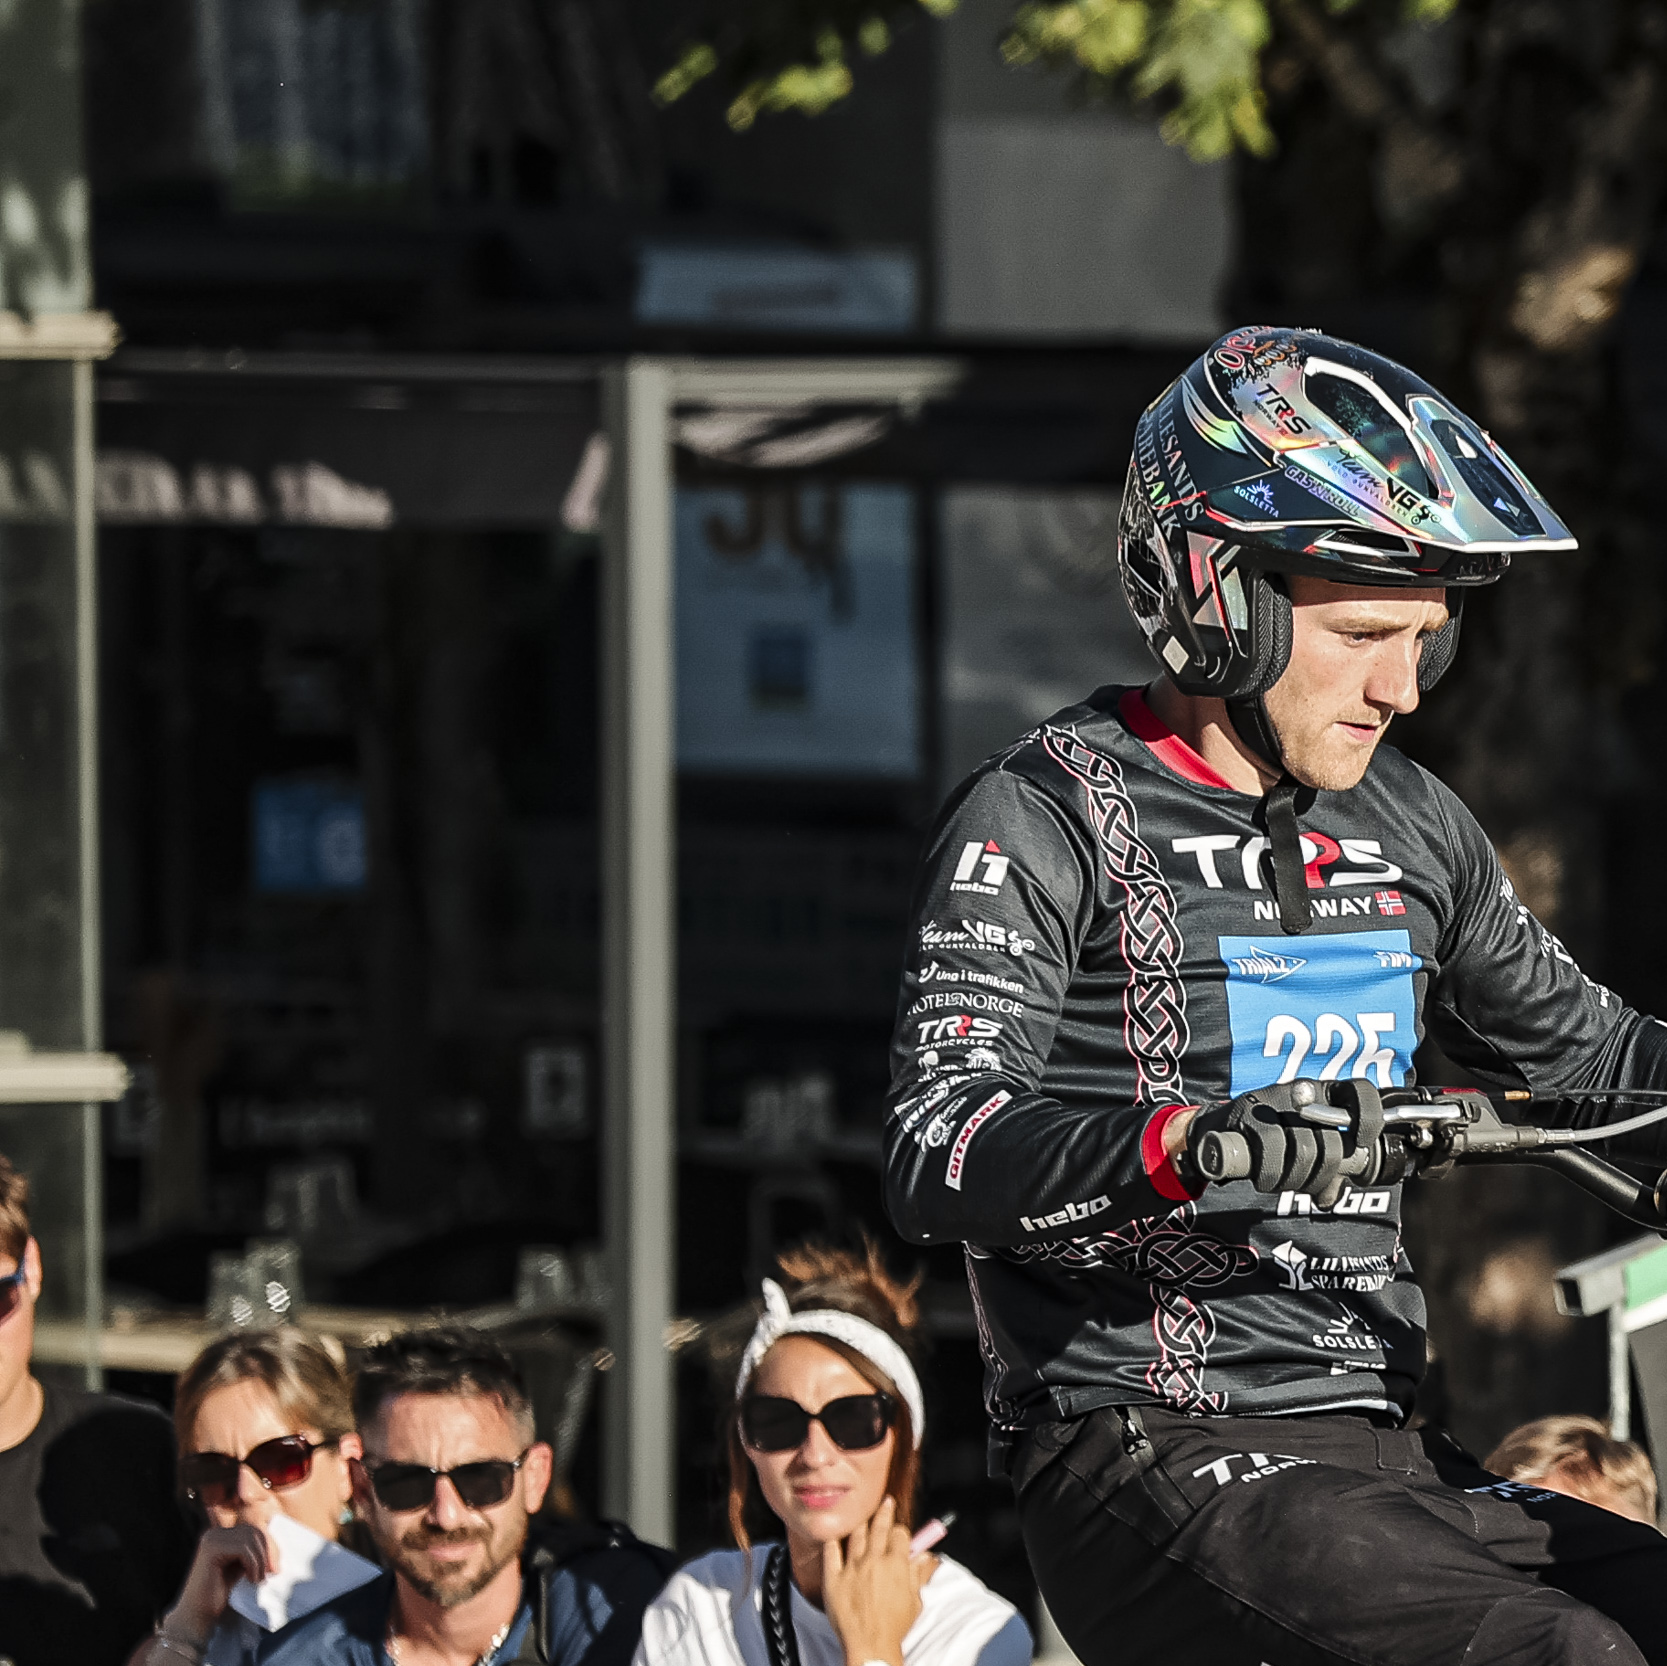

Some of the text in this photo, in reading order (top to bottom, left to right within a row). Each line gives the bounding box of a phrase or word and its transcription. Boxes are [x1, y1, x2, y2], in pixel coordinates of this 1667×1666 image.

[1233, 485, 1280, 518] SOLSLETTA
[1253, 896, 1373, 920] NWAY
[967, 971, 1024, 994] trafikken
[957, 993, 1024, 1018] NORGE
[950, 1096, 1004, 1180] GITMARK
[1020, 1195, 1113, 1232] hebo
